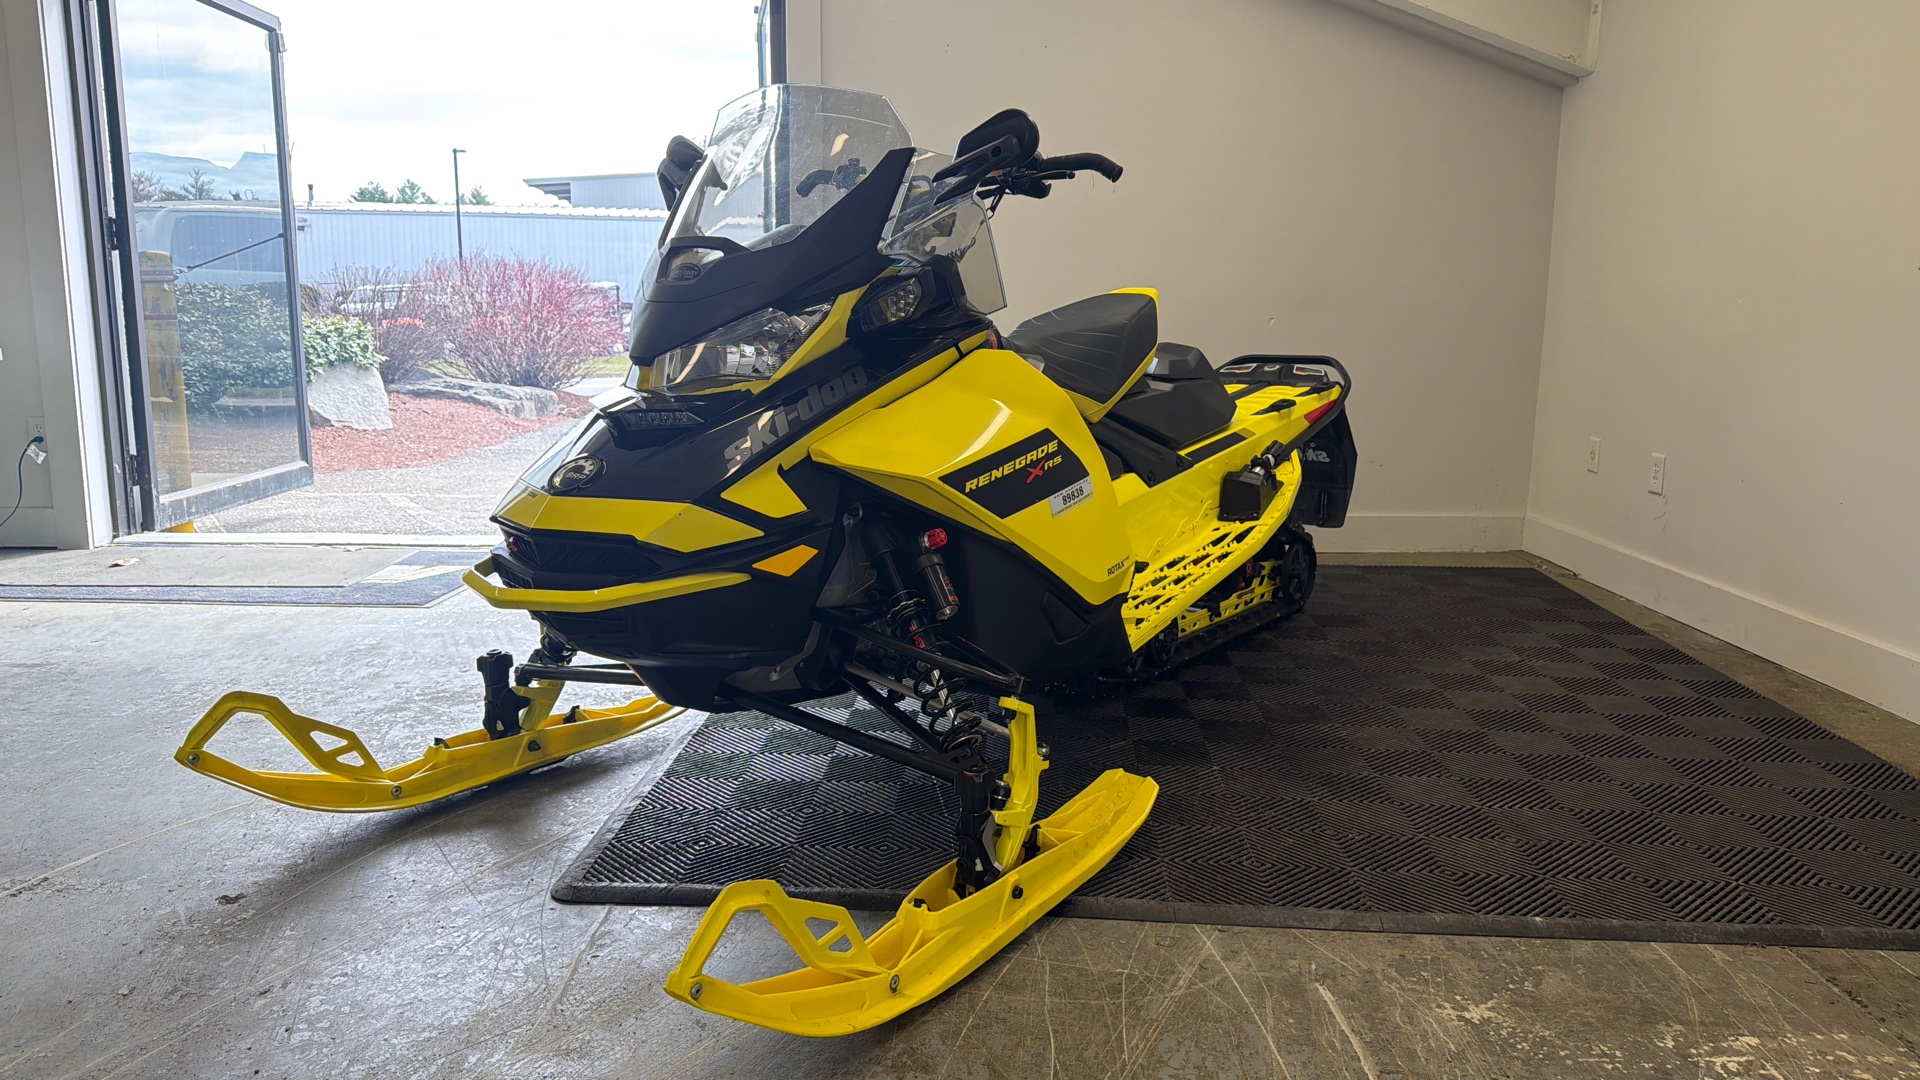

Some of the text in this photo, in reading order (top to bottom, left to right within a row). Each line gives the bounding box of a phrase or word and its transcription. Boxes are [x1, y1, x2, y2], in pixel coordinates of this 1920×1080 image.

[965, 439, 1059, 493] RENEGADE
[565, 471, 586, 480] BRP
[1062, 485, 1084, 506] 89838
[1107, 561, 1125, 576] ROTAX
